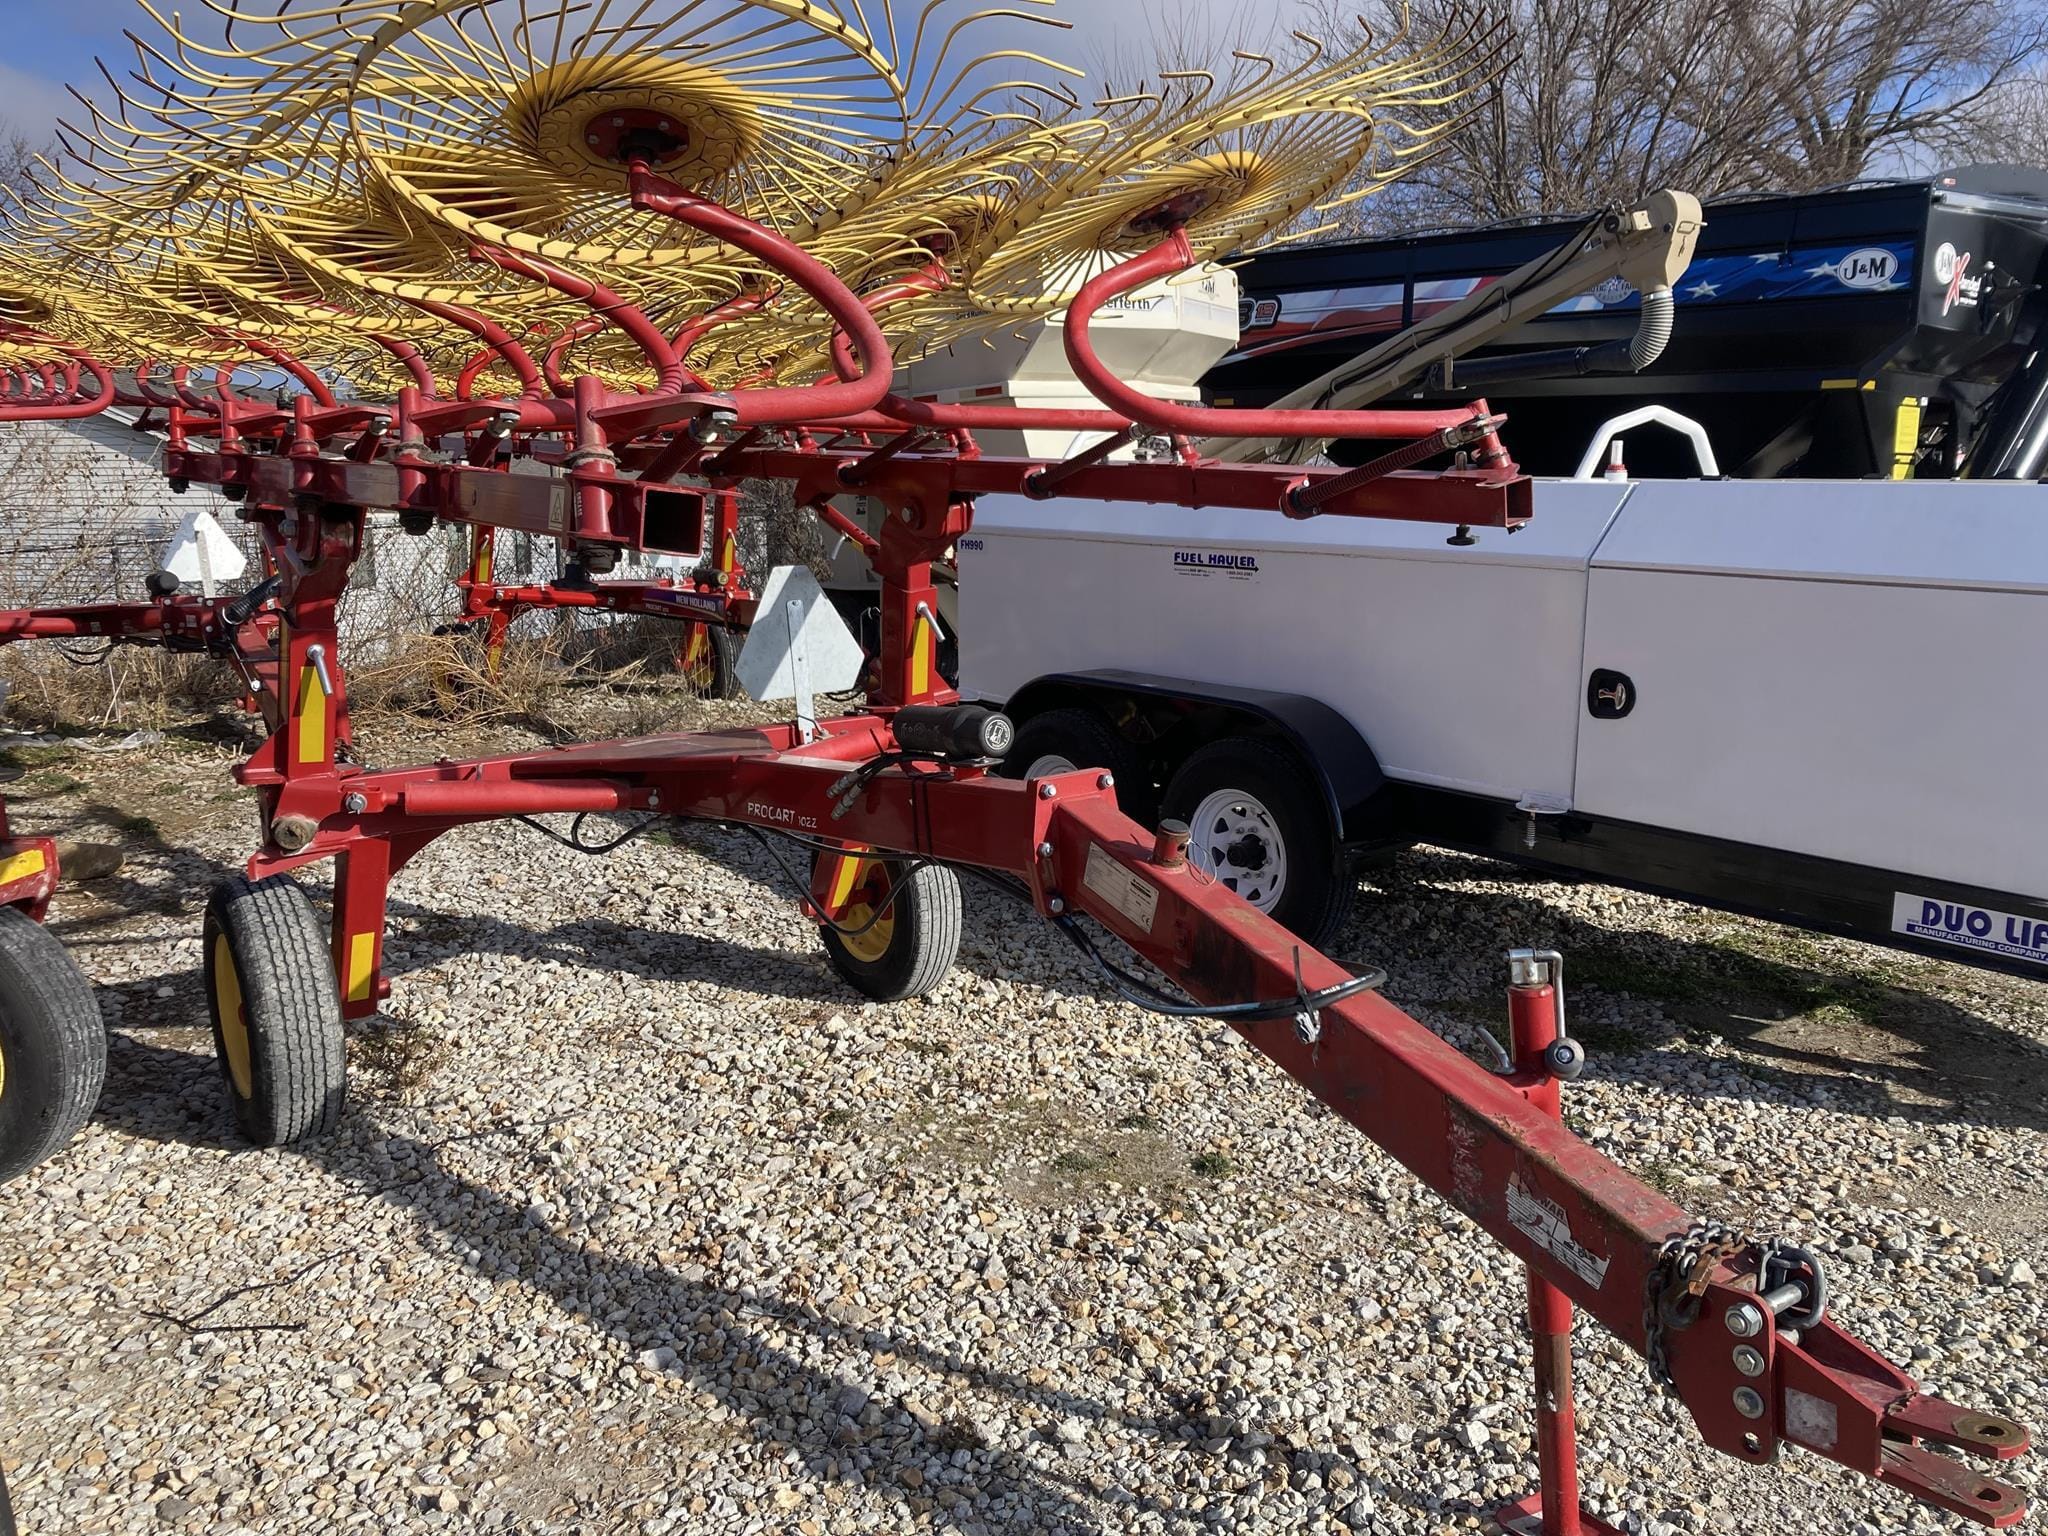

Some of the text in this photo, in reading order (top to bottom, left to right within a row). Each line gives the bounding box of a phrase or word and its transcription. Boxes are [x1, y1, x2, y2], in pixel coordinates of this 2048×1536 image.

[1844, 257, 1890, 280] J&M
[960, 540, 983, 551] FH990
[1174, 551, 1255, 568] FUEL HAULER
[689, 597, 716, 612] HOLLAND
[747, 802, 817, 829] PROCART 1022
[1921, 900, 2048, 949] DUO LIF
[1914, 926, 1996, 949] MANUFACTURING
